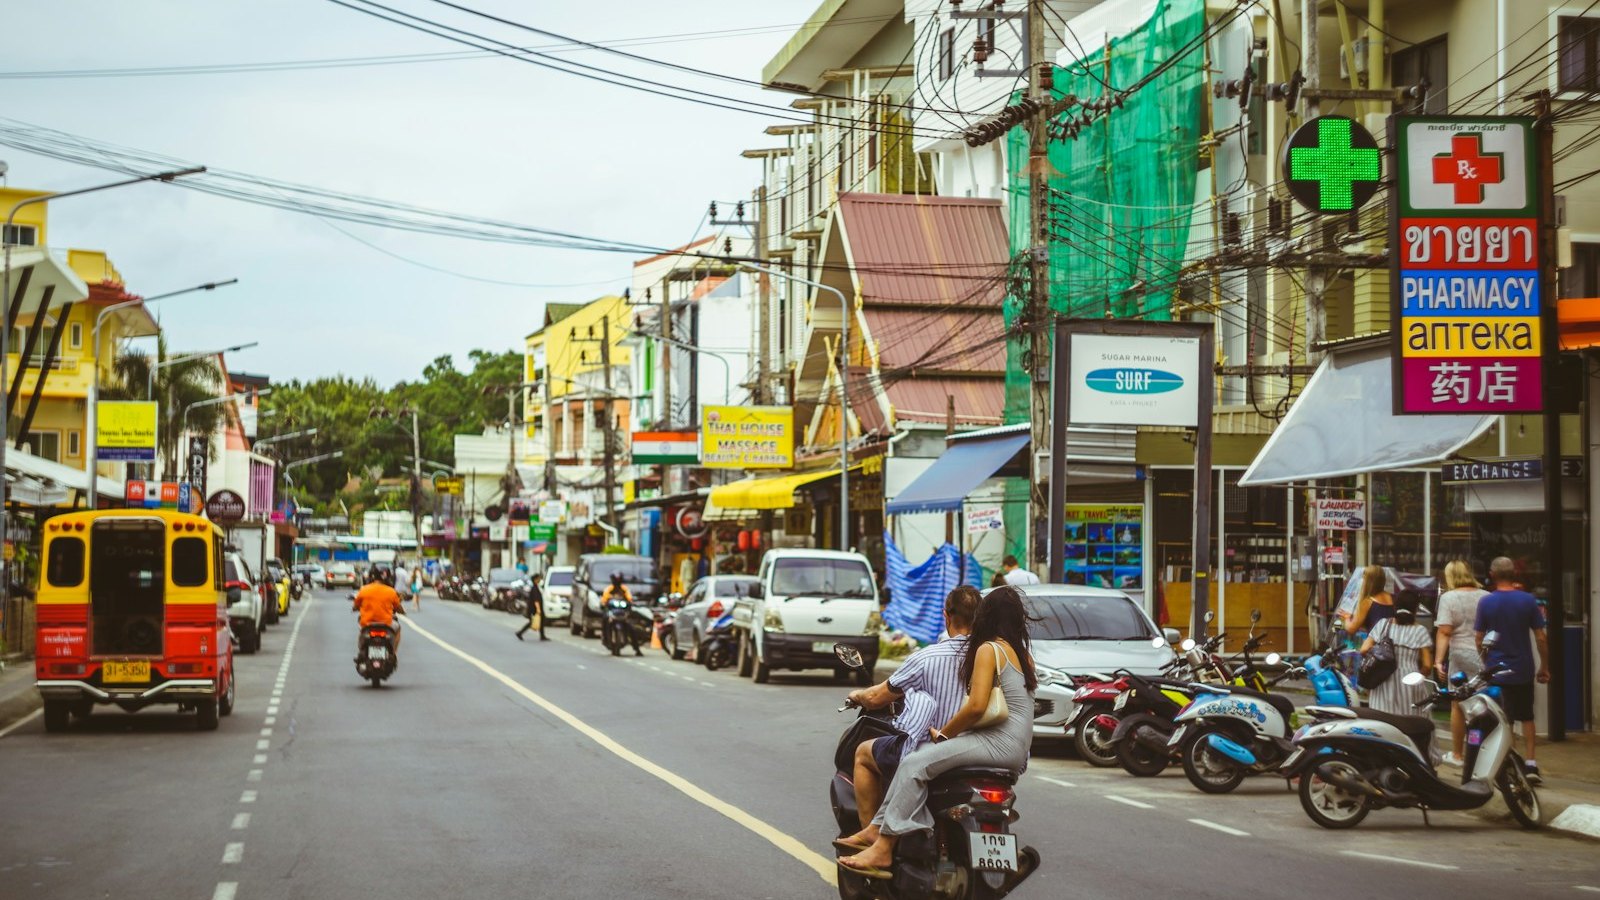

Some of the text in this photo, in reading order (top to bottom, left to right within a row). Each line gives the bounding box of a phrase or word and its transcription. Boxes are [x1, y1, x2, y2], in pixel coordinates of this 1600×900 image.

[1405, 225, 1532, 263] ขายยา
[1403, 276, 1535, 310] PHARMACY
[1408, 322, 1533, 350] аптека
[1101, 353, 1130, 361] SUGAR
[1115, 371, 1152, 391] SURF
[1429, 361, 1517, 404] 药店
[708, 422, 784, 436] THAI HOUSE
[718, 440, 777, 453] MASSAGE
[1453, 461, 1530, 480] EXCHANGE
[1319, 501, 1364, 511] LAUNDRY
[1323, 511, 1356, 519] SERVICE
